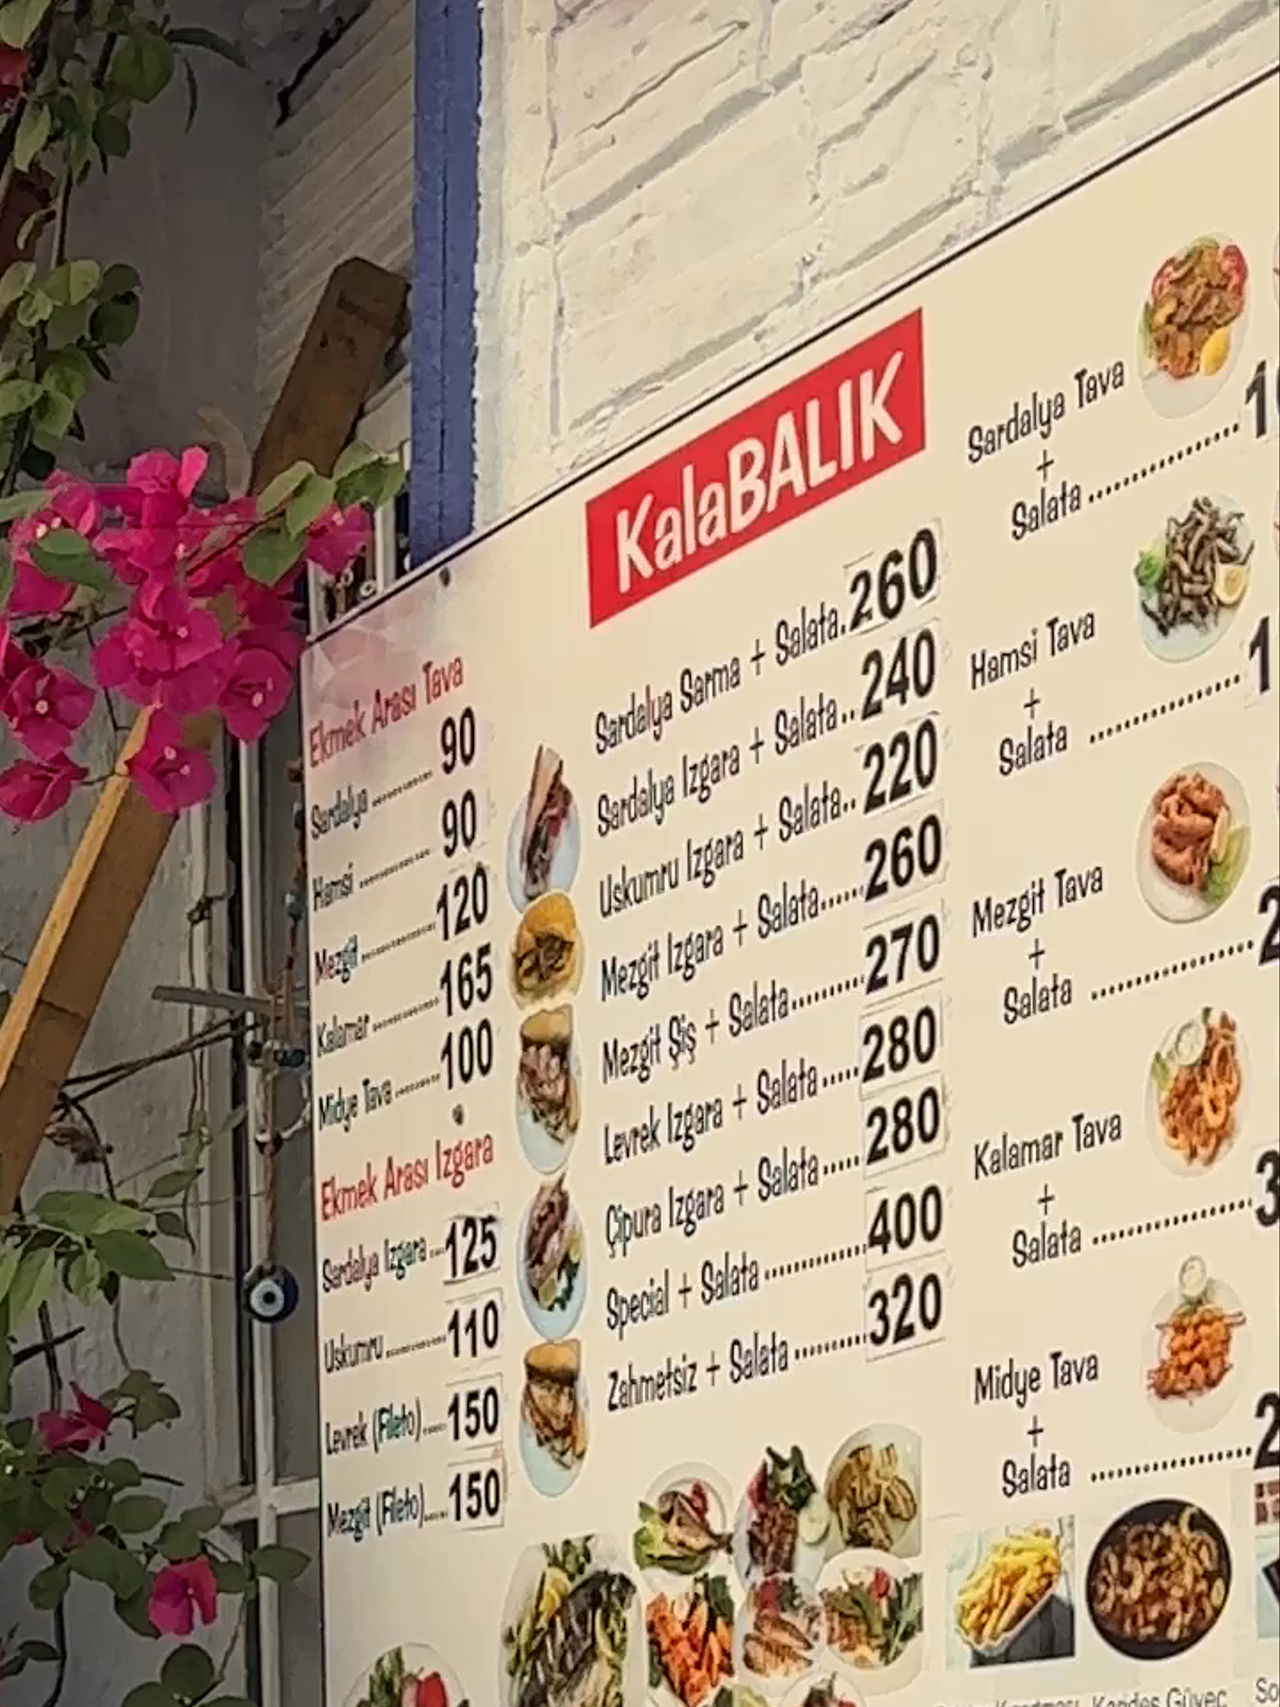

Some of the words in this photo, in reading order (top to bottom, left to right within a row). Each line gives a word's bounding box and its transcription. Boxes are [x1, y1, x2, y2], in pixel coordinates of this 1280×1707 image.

[968, 391, 1065, 463] Sardalya
[1074, 361, 1124, 408] Tava
[616, 350, 904, 594] KalaBALIK
[1012, 480, 1081, 541] Salata
[596, 684, 673, 754] Sardalya
[681, 657, 741, 712] Sarma
[775, 602, 839, 666] Salata
[848, 528, 937, 632] 260
[971, 627, 1038, 690] Hamsi
[1047, 613, 1095, 656] Tava
[310, 699, 366, 768] Ekmek
[371, 689, 416, 733] Arası
[423, 656, 463, 704] Tava
[597, 768, 675, 837] Sardalya
[682, 745, 741, 803] Izgara
[775, 693, 837, 755] Salata
[861, 628, 936, 720] 240
[999, 720, 1067, 776] Salata
[312, 783, 368, 840] Sardalya
[442, 706, 476, 774] 90
[600, 857, 679, 918] Uskumru
[686, 830, 744, 888] Izgara
[779, 780, 841, 842] Salata
[863, 717, 938, 815] 220
[313, 862, 353, 912] Hamsi
[442, 789, 477, 857] 90
[436, 861, 488, 941] 120
[601, 938, 660, 1001] Mezgit
[667, 924, 724, 981] Izgara
[758, 878, 819, 939] Salata
[864, 814, 942, 902] 260
[972, 877, 1045, 938] Mezgit
[1054, 866, 1103, 907] Tava
[440, 942, 492, 1017] 165
[603, 1025, 660, 1084] Mezgit
[668, 1014, 696, 1071] Şiş
[728, 979, 789, 1037] Salata
[865, 913, 940, 995] 270
[1003, 973, 1072, 1025] Salata
[319, 1087, 358, 1133] Midye
[362, 1078, 392, 1114] Tava
[441, 1017, 493, 1090] 100
[604, 1105, 661, 1165] Levrek
[668, 1097, 723, 1152] Izgara
[757, 1058, 818, 1115] Salata
[862, 1005, 937, 1083] 280
[320, 1162, 378, 1222] Ekmek
[384, 1156, 429, 1199] Arası
[436, 1133, 494, 1188] Izgara
[606, 1202, 661, 1258] Çipura
[669, 1183, 724, 1237] Izgara
[758, 1146, 819, 1202] Salata
[866, 1086, 940, 1166] 280
[973, 1131, 1063, 1180] Kalamar
[1071, 1112, 1122, 1152] Tava
[322, 1244, 379, 1293] Sardalya
[444, 1215, 497, 1278] 125
[607, 1269, 669, 1341] Special
[701, 1251, 759, 1306] Salata
[868, 1185, 942, 1254] 400
[1012, 1220, 1081, 1268] Salata
[323, 1333, 384, 1374] Uskumru
[447, 1300, 500, 1358] 110
[608, 1353, 697, 1412] Zahmetsiz
[730, 1332, 789, 1384] Salata
[868, 1272, 942, 1346] 320
[973, 1358, 1041, 1408] Midye
[1049, 1351, 1099, 1389] Tava
[325, 1411, 368, 1455] Levrek
[447, 1387, 500, 1441] 150
[326, 1496, 371, 1543] Mezgit
[448, 1469, 501, 1522] 150
[1002, 1452, 1071, 1497] Salata
